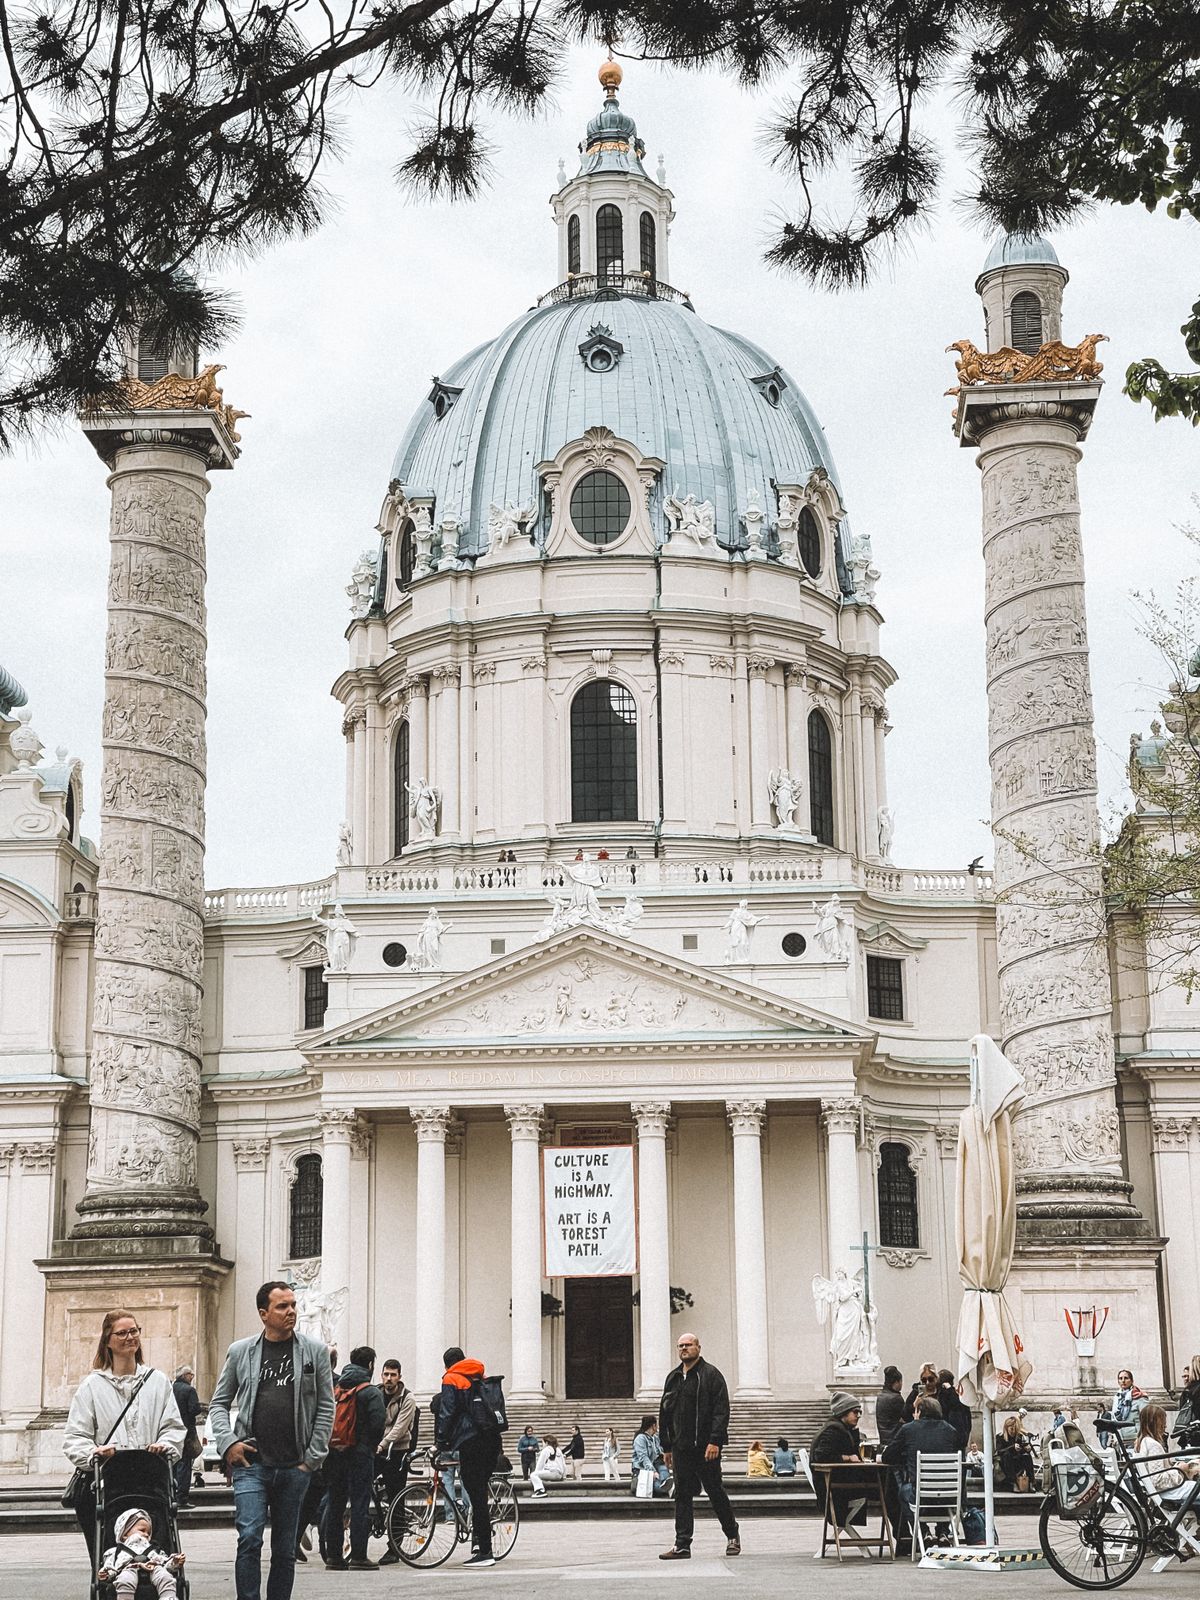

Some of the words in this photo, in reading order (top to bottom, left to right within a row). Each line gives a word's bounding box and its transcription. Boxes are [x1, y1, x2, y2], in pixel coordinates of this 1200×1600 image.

[554, 1154, 609, 1168] CULTURE
[586, 1170, 594, 1181] A
[558, 1213, 581, 1225] ART
[602, 1212, 611, 1224] A
[568, 1243, 602, 1257] PATH.
